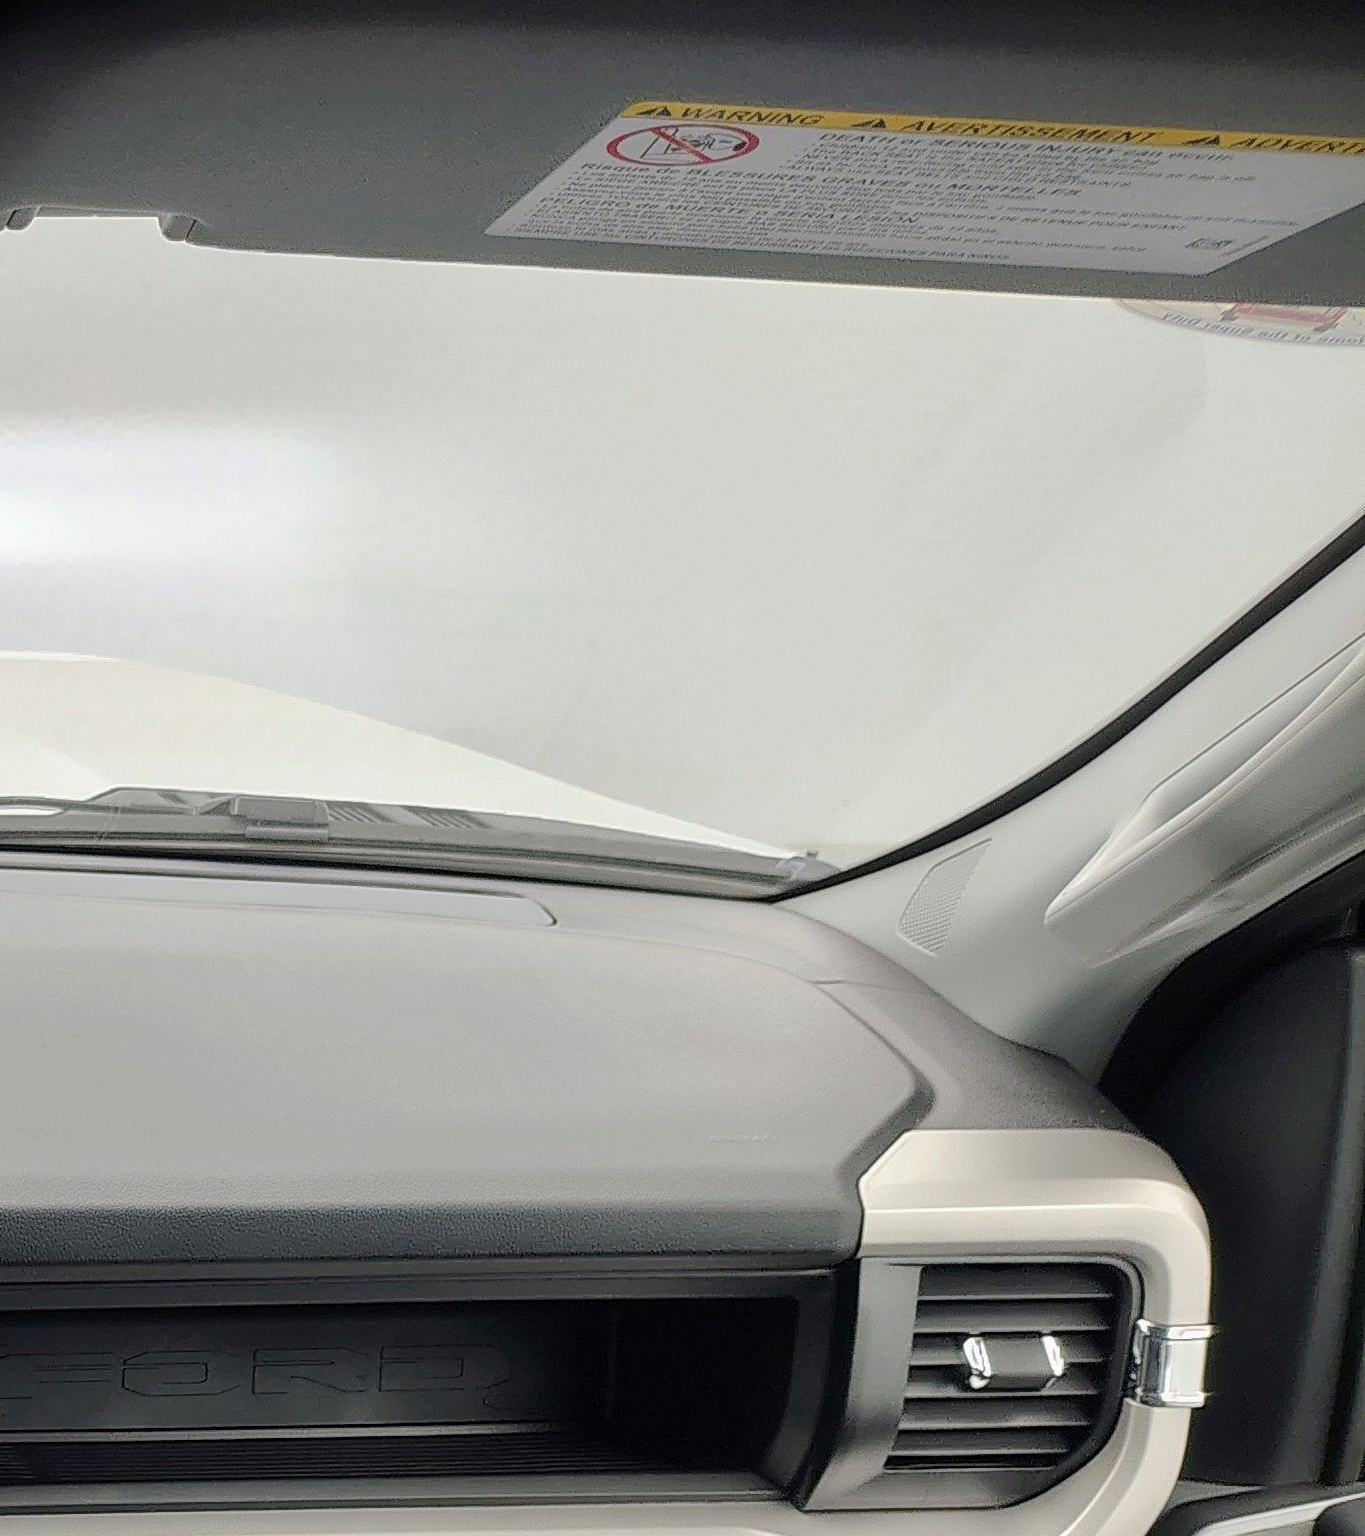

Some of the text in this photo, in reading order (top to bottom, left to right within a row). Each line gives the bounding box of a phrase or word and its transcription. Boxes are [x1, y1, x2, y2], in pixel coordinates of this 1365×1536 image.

[680, 106, 1365, 155] WARNING AVERTISSEMENT ADVERT
